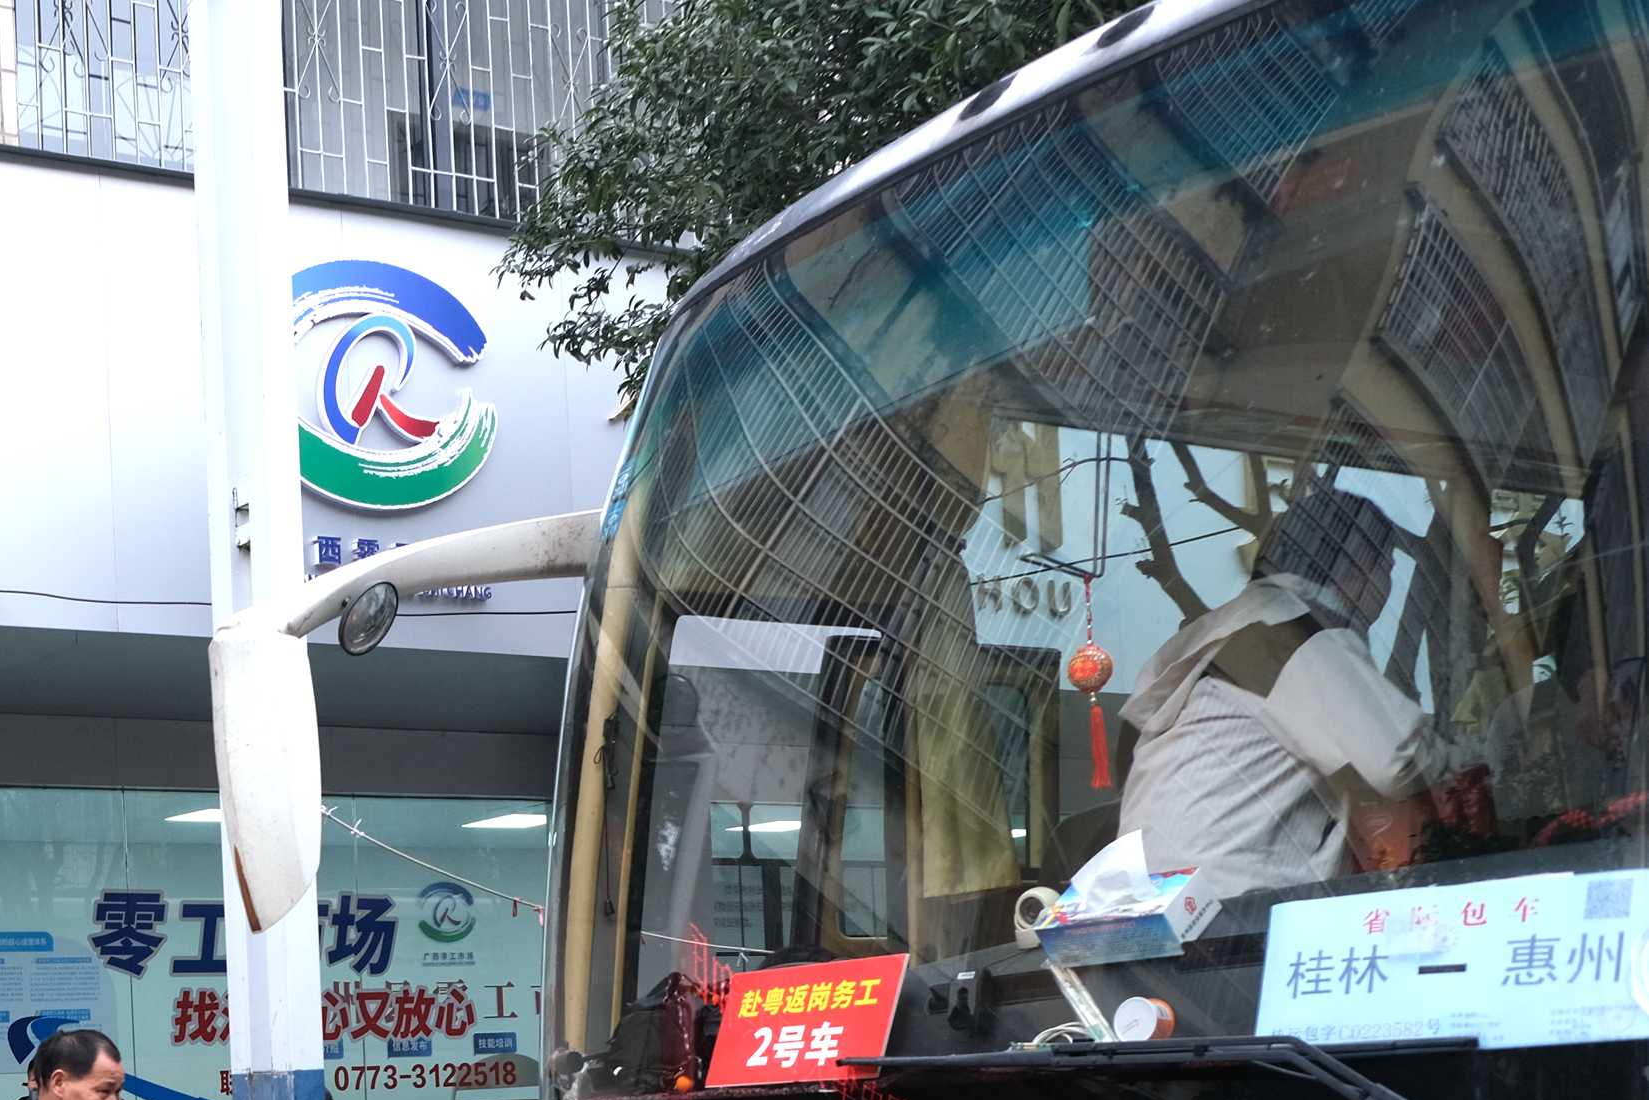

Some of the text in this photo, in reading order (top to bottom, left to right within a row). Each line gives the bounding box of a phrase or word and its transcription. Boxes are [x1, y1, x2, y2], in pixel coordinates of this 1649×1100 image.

[89, 888, 398, 978] 零工场
[1286, 944, 1390, 1000] 桂林
[1501, 931, 1625, 987] 惠州
[738, 978, 881, 1019] 赴粤返岗务工
[478, 1036, 514, 1049] 技能培训
[746, 1021, 844, 1069] 2号车
[334, 1060, 517, 1092] 0773-3122518
